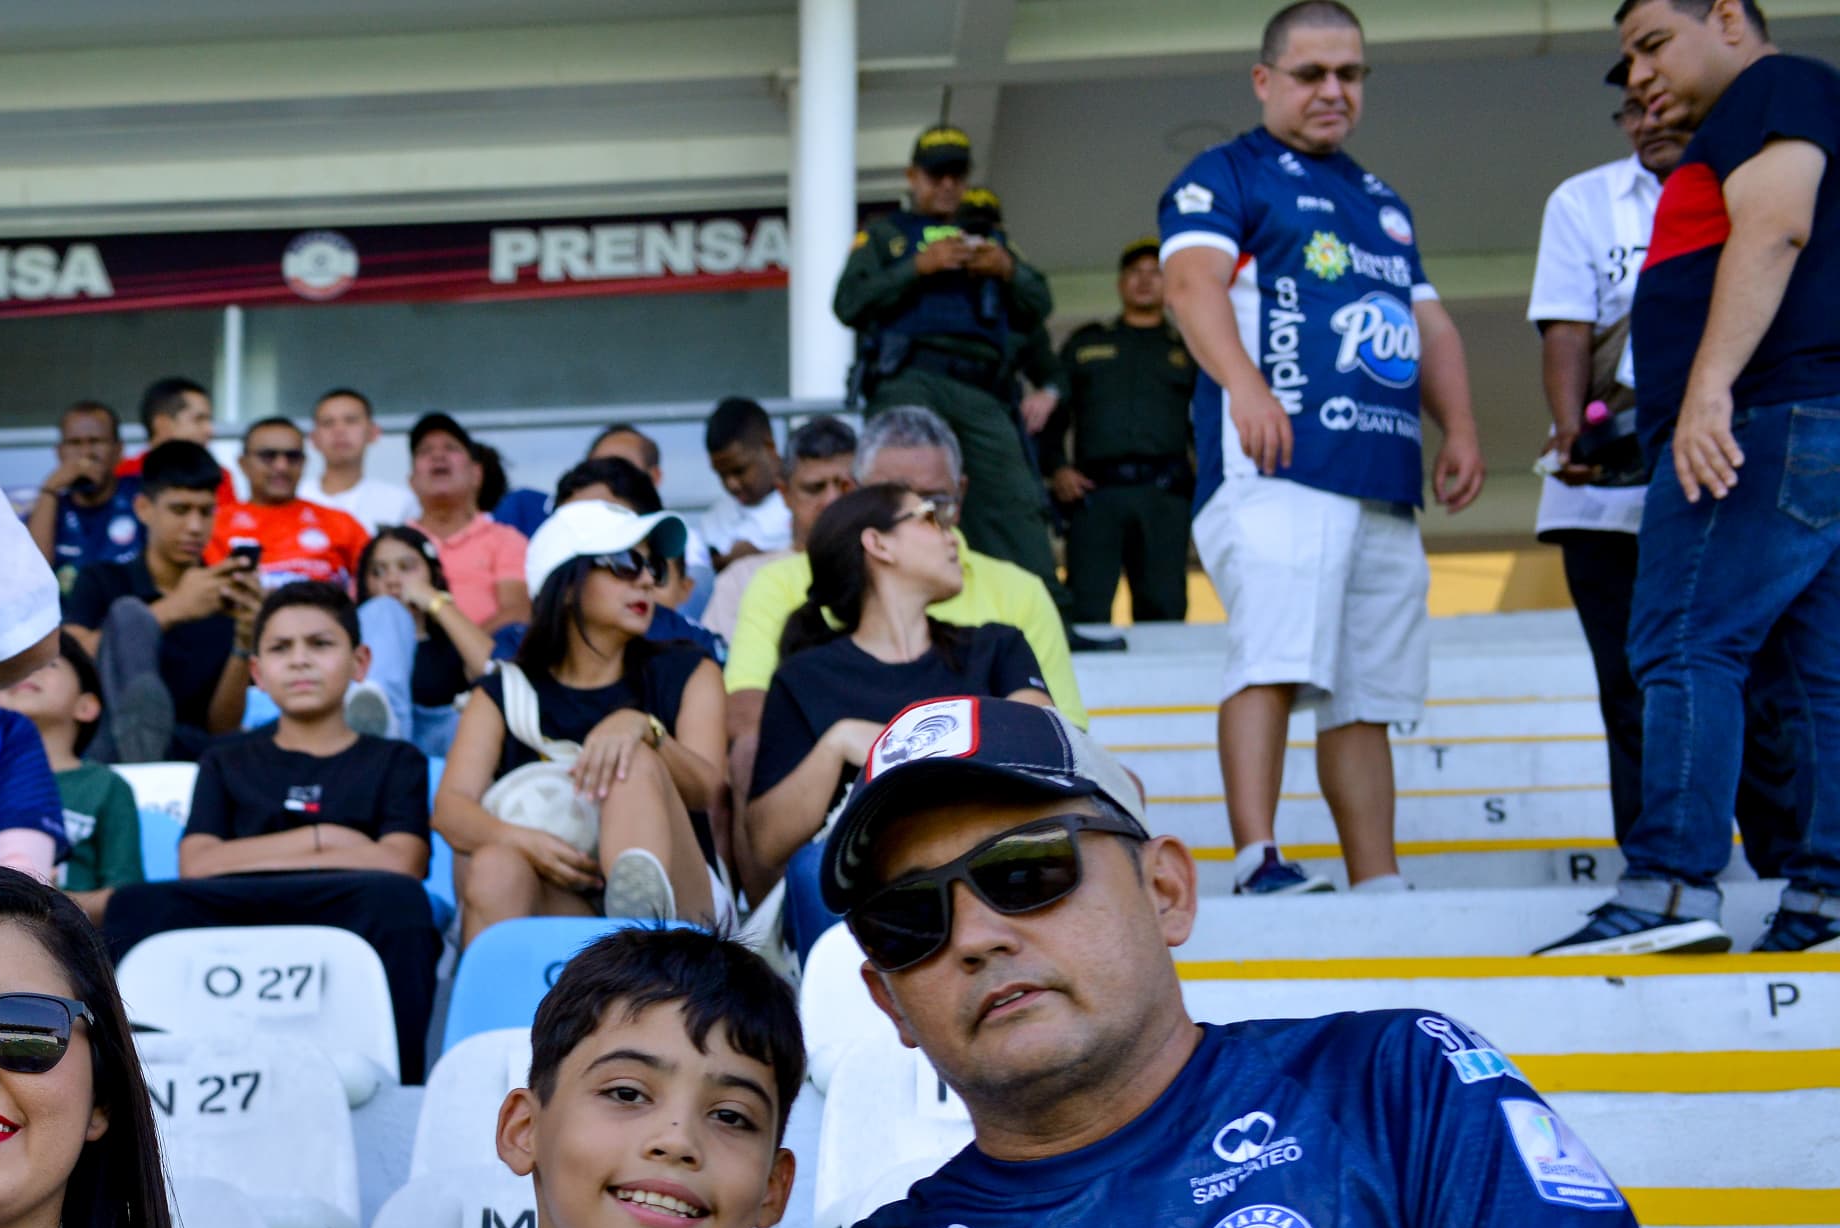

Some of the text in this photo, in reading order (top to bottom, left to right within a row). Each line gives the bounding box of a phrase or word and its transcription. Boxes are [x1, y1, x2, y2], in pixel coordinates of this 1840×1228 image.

[489, 217, 790, 284] PRENSA
[1484, 798, 1506, 824] S
[1569, 853, 1596, 881] R
[205, 965, 313, 1000] O 27
[1768, 984, 1800, 1017] P
[198, 1071, 262, 1113] 27
[1193, 1179, 1236, 1204] SAN
